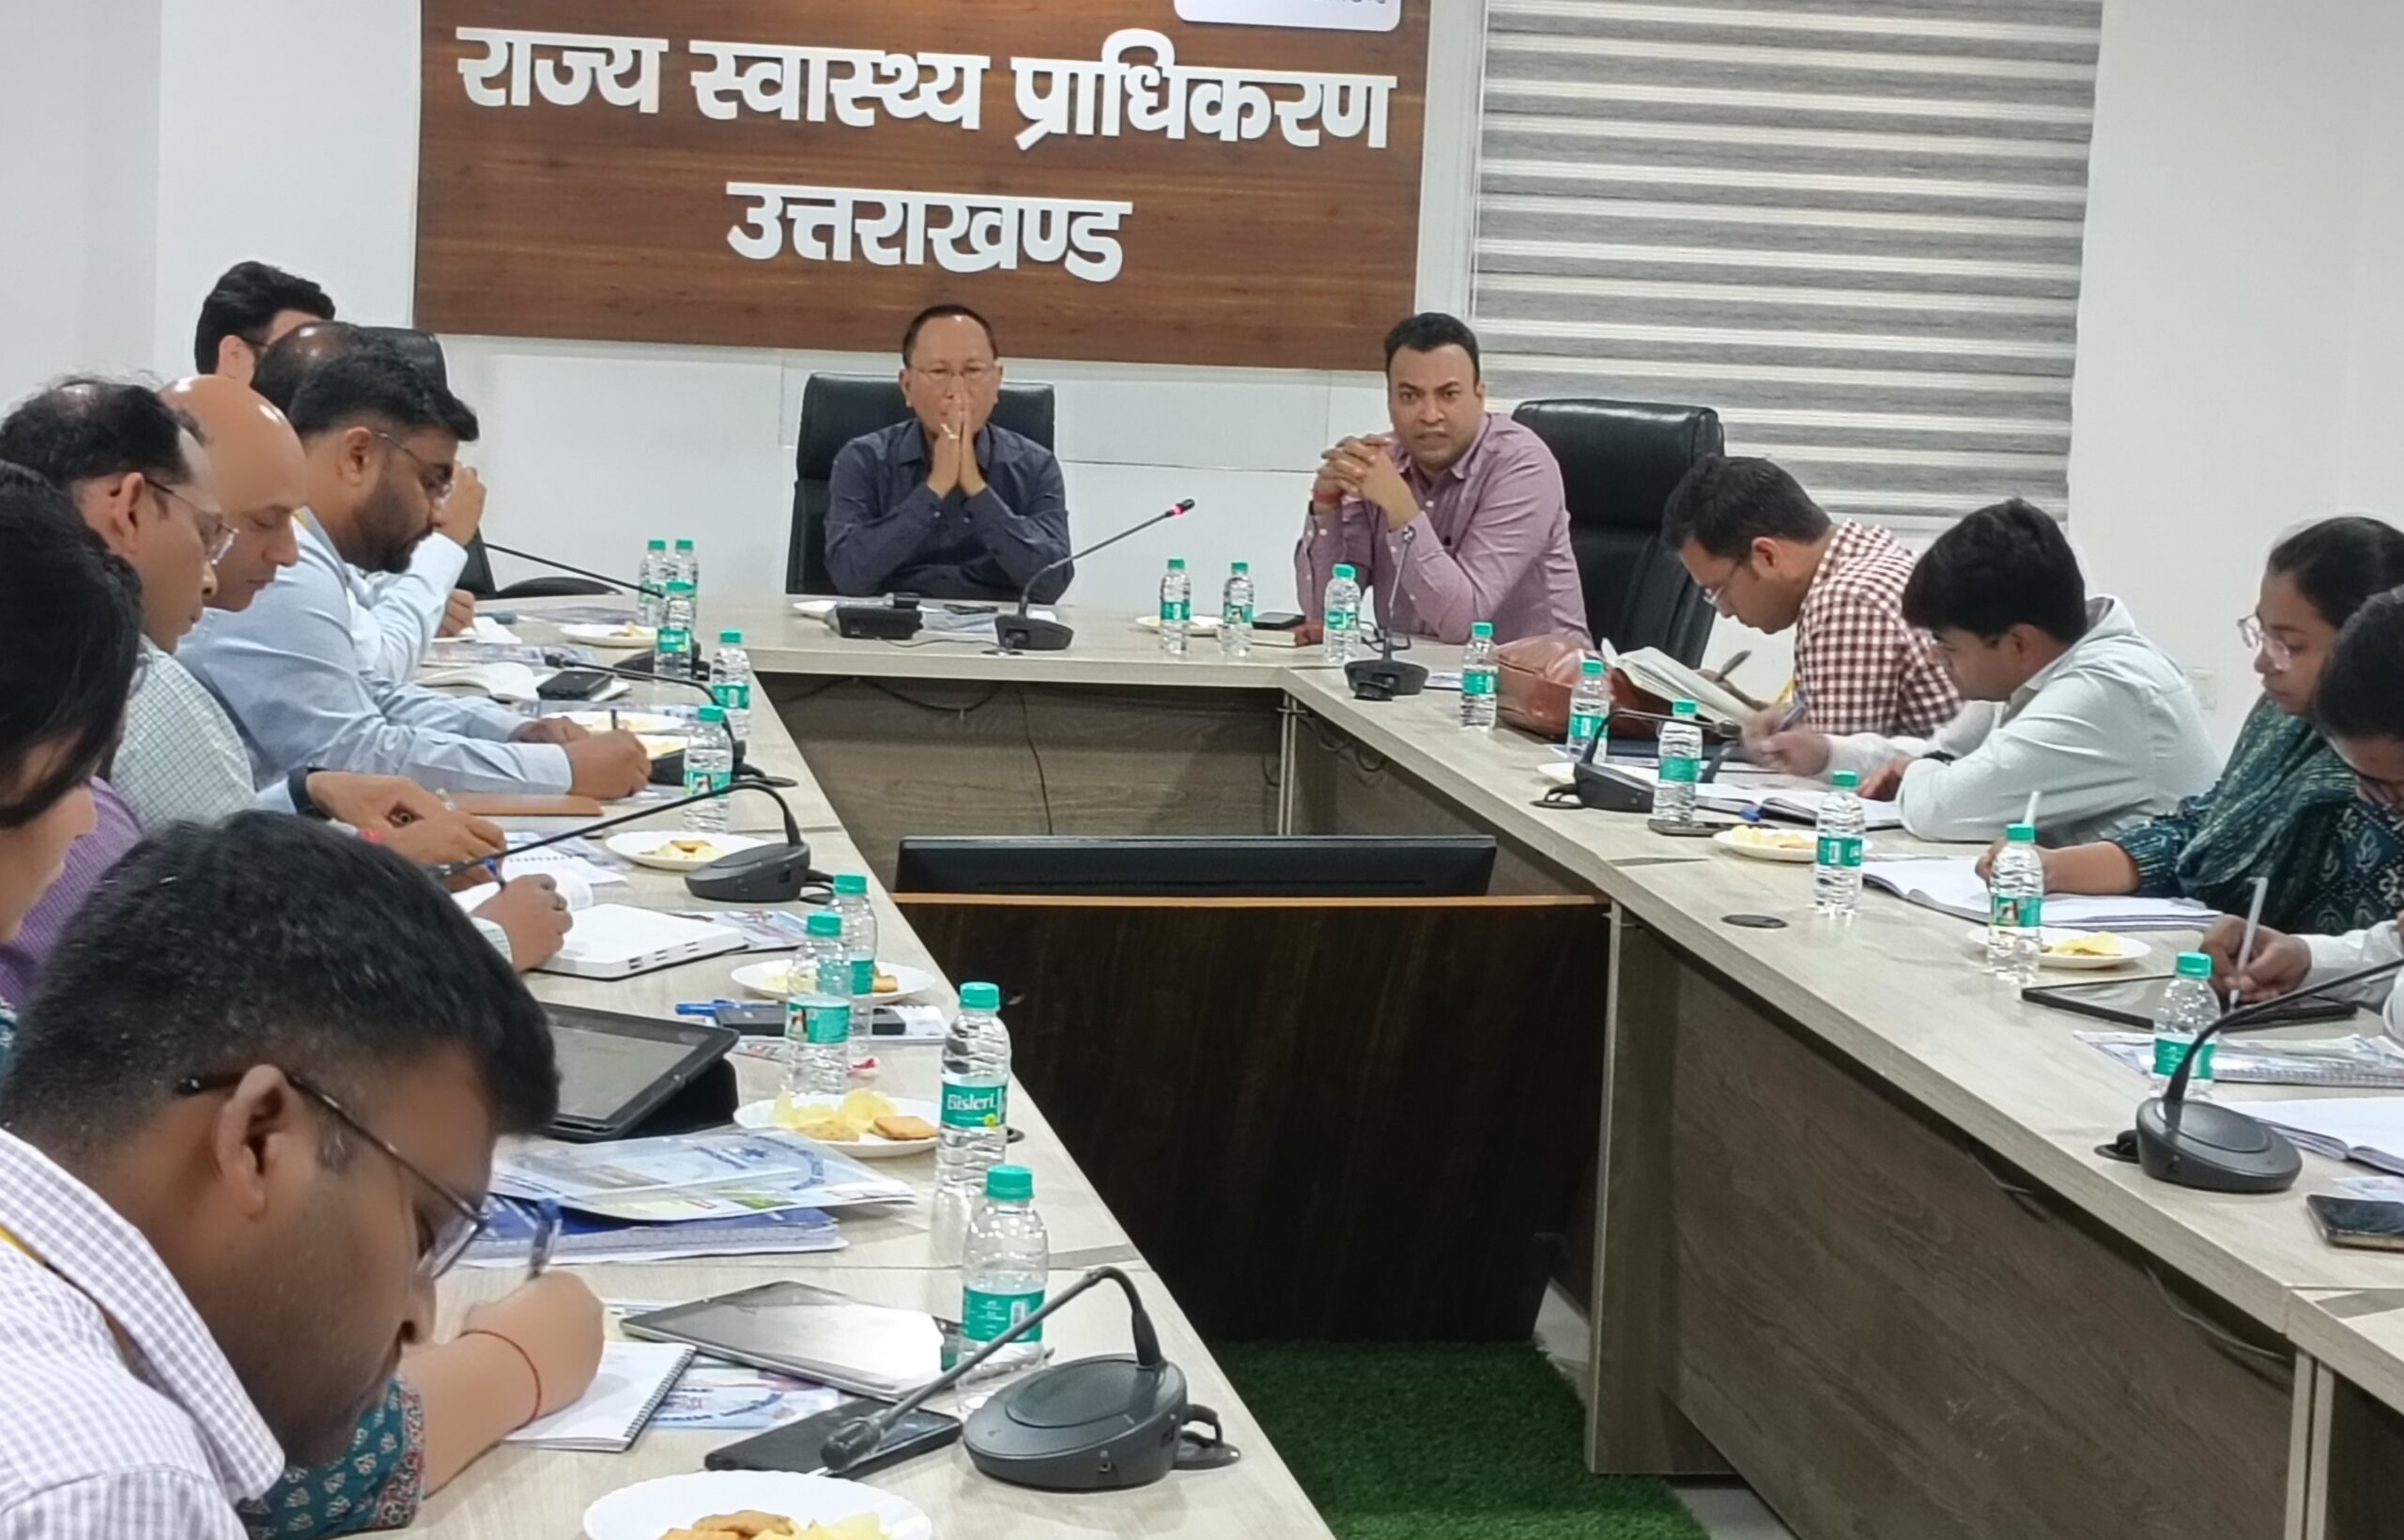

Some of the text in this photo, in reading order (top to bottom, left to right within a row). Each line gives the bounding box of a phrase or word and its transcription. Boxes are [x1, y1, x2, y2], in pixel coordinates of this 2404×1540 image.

[456, 26, 1398, 151] राज्य स्वास्थ्य प्राधिकरण
[726, 181, 1133, 284] उत्तराखण्ड
[946, 1092, 998, 1111] Bisleri
